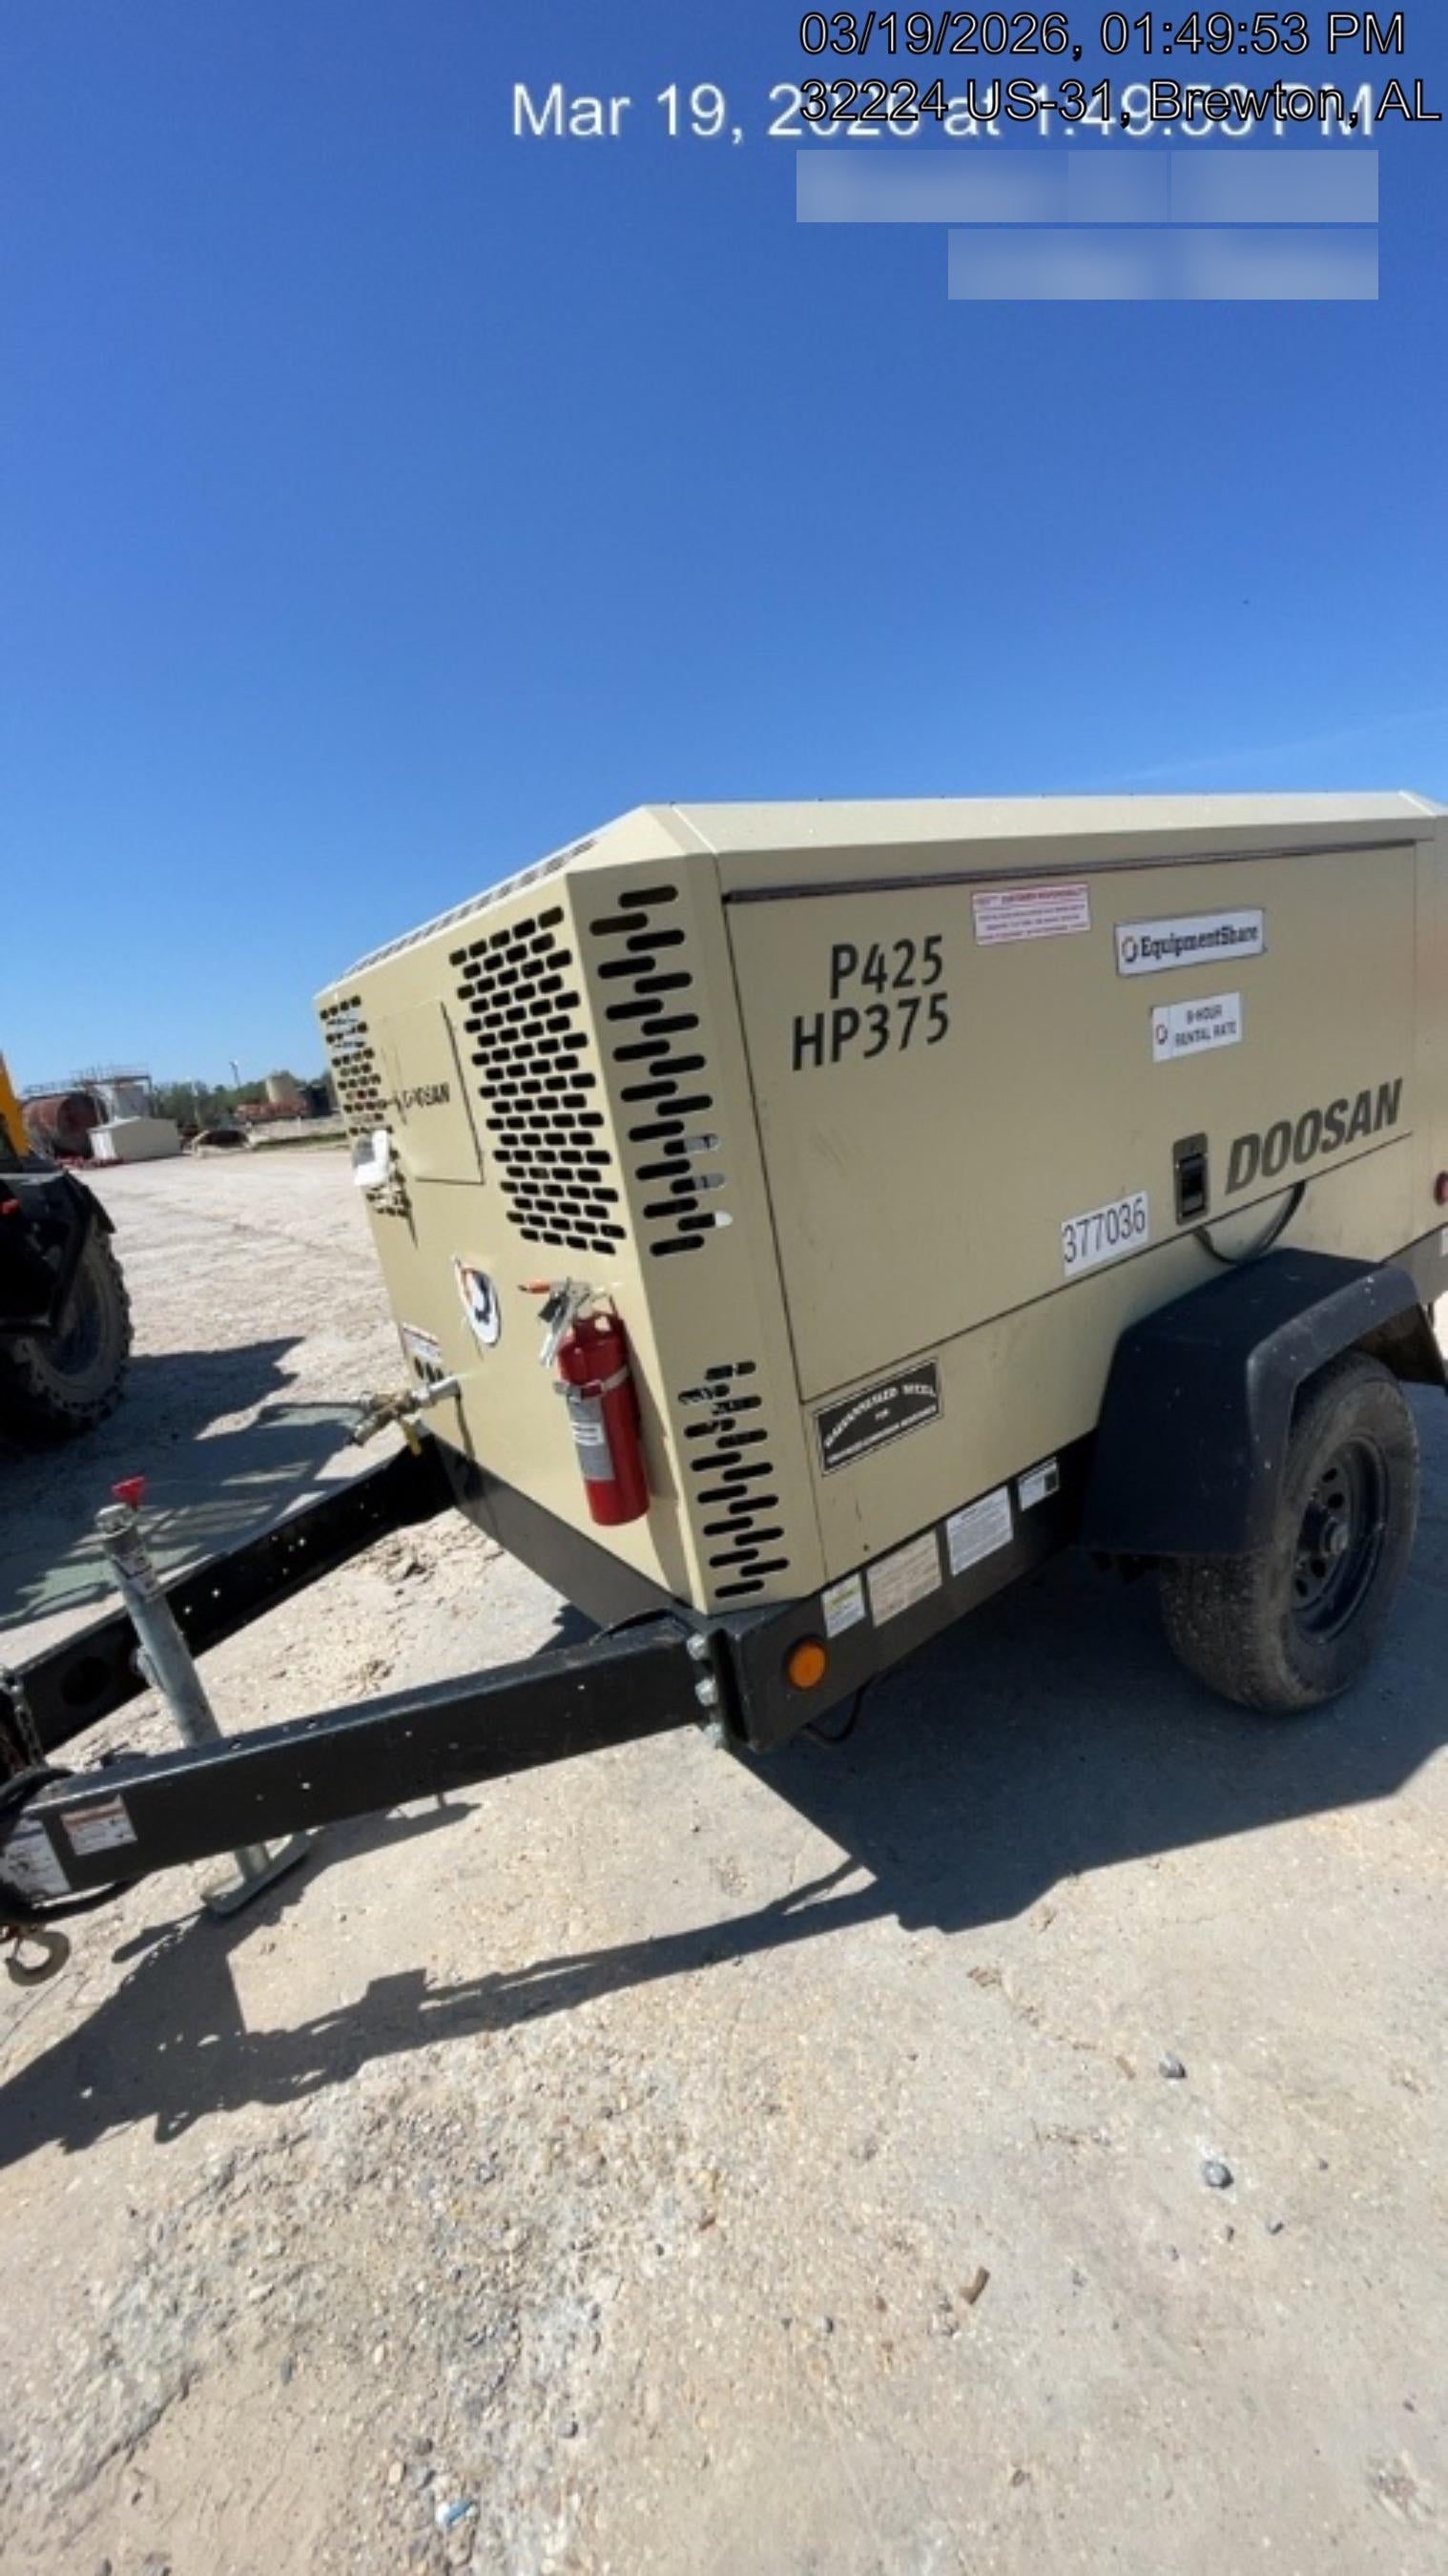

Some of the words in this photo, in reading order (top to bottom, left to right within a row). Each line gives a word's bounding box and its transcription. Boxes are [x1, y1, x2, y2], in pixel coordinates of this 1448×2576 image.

[829, 934, 943, 1000] P425
[1140, 924, 1258, 960] EquipmentShare
[791, 991, 950, 1071] HP375
[1174, 1028, 1211, 1048] RENTAL
[1212, 1021, 1237, 1039] RATE
[1225, 1076, 1403, 1195] DOOSAN
[1062, 1195, 1146, 1274] 377036
